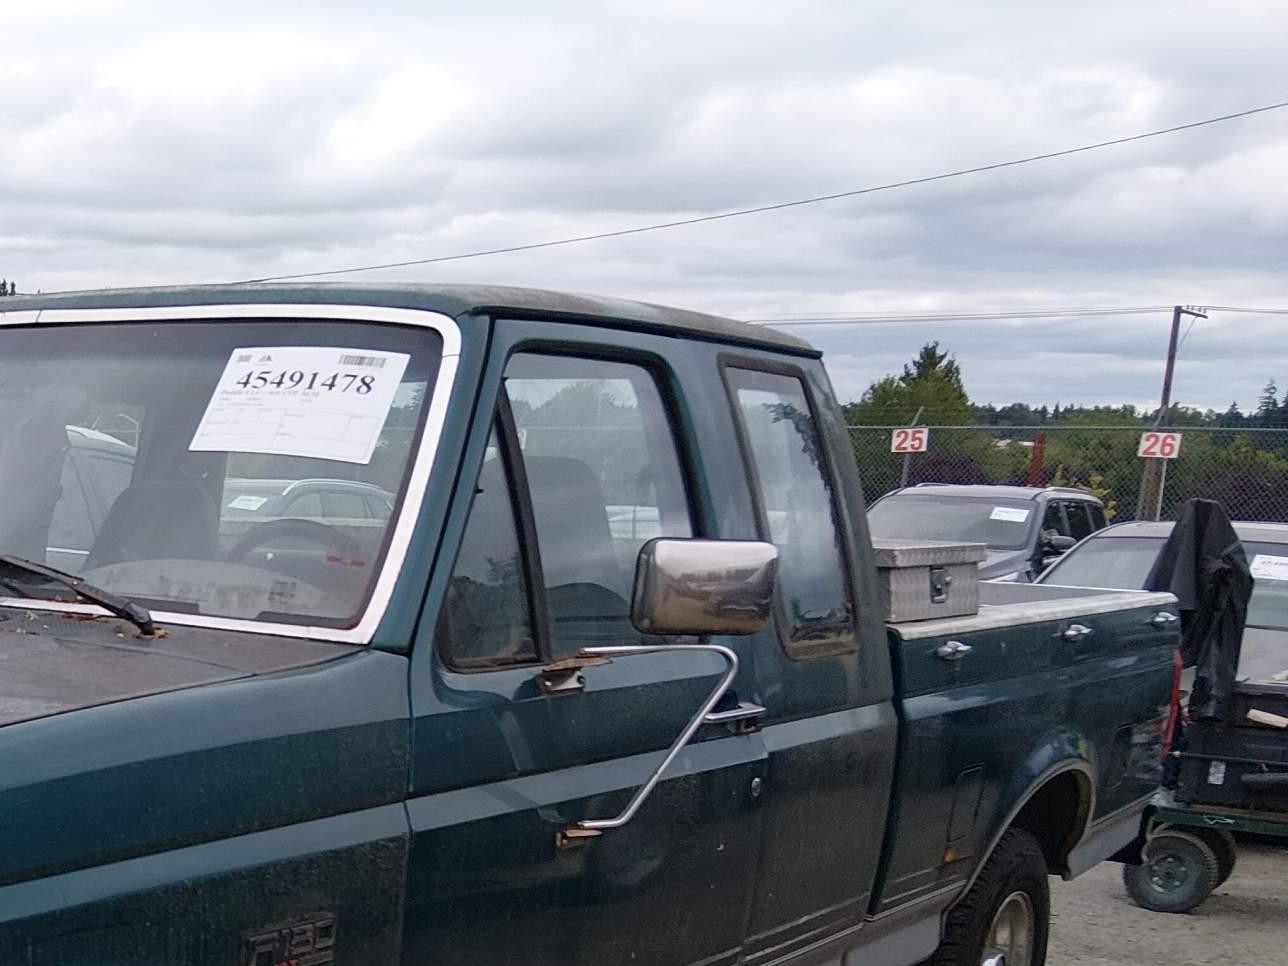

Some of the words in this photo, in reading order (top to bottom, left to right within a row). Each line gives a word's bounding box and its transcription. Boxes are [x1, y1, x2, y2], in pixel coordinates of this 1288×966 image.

[236, 370, 376, 395] 45491478
[895, 430, 924, 451] 25
[1142, 434, 1175, 456] 26
